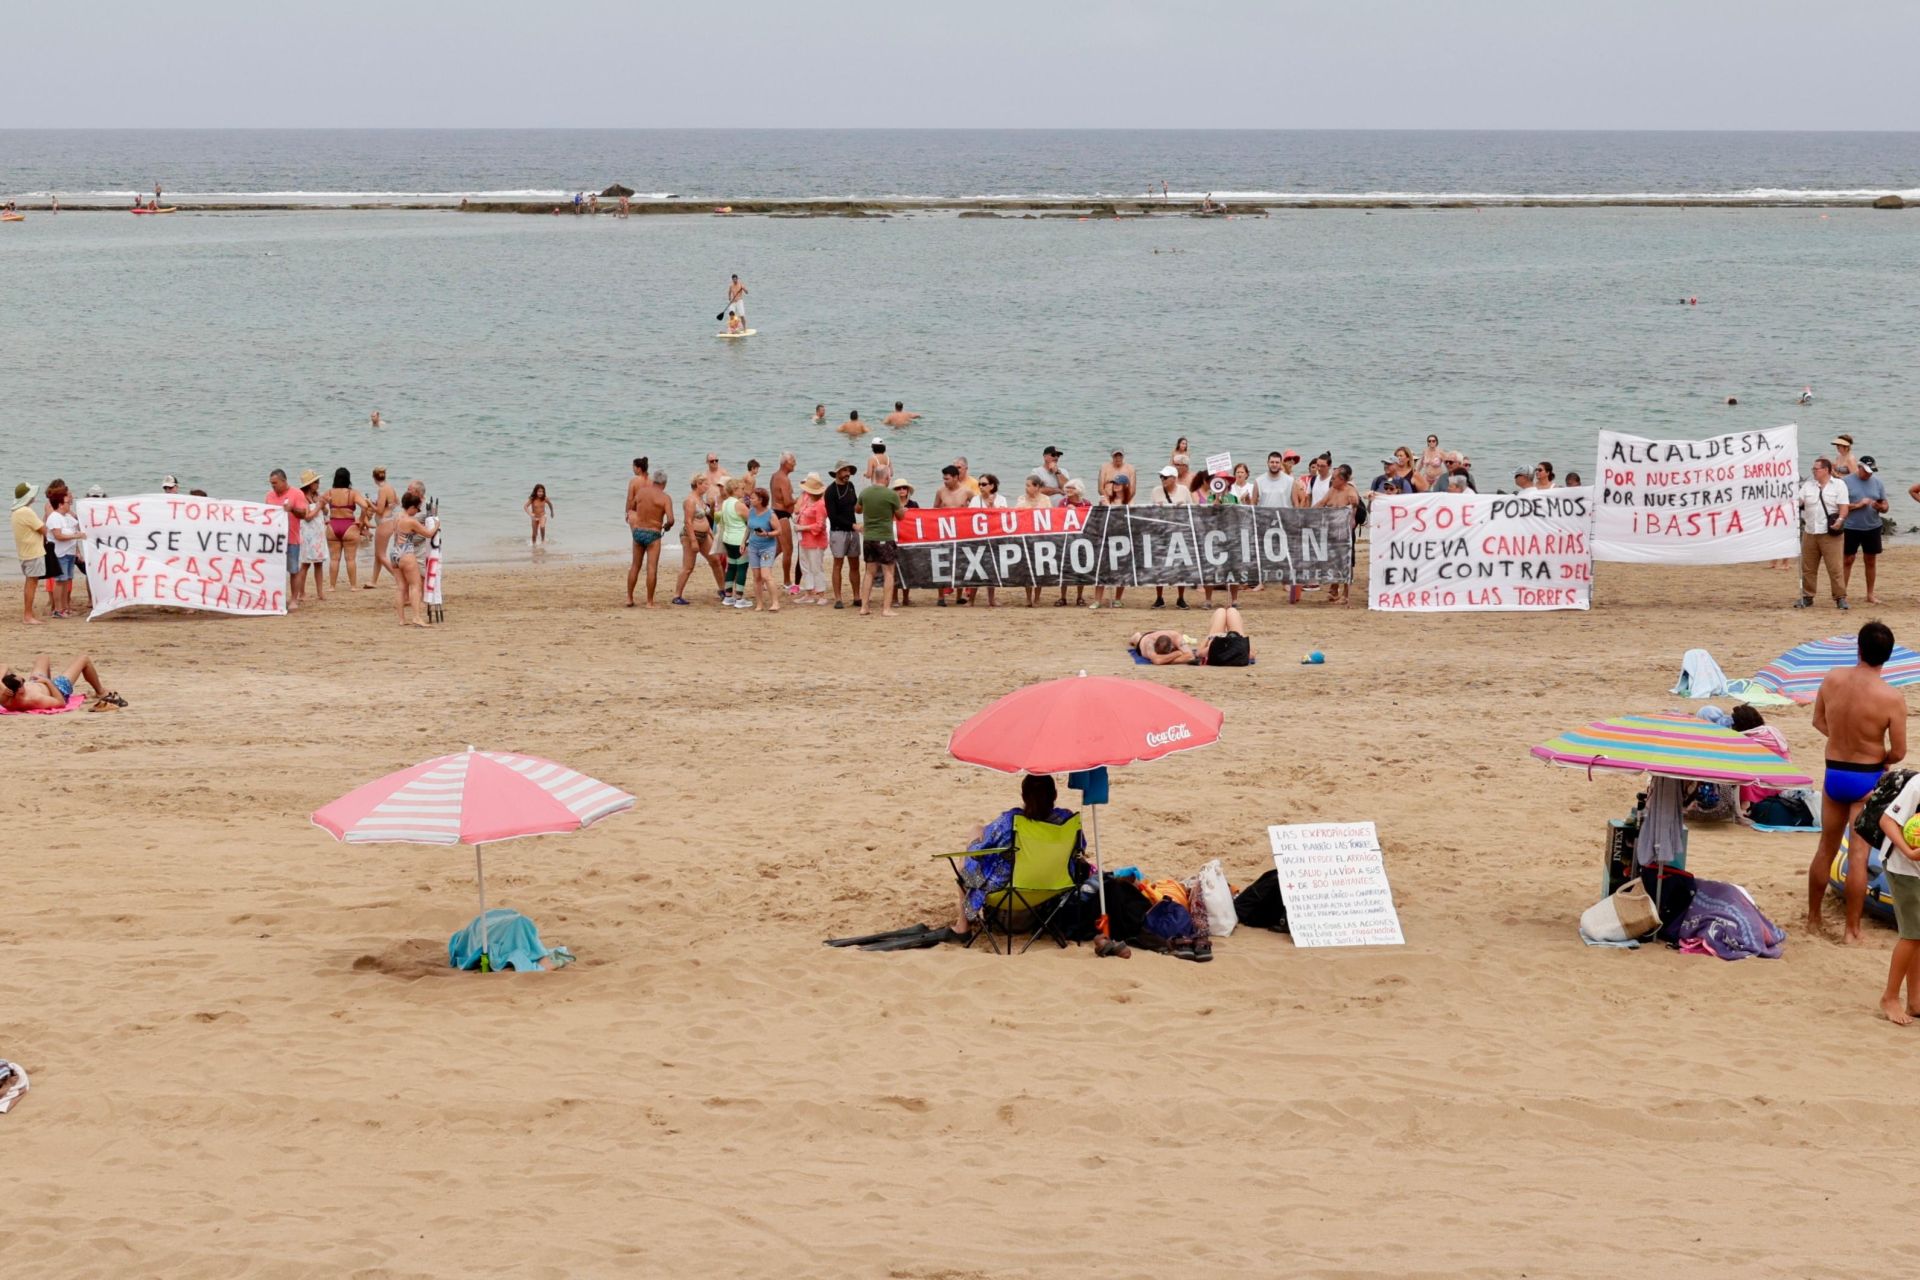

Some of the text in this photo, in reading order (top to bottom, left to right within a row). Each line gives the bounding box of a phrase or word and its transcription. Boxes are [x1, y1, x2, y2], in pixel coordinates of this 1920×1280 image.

[1605, 456, 1793, 486] POR NUESTROS BARRIOS
[1603, 480, 1794, 507] POR NUESTRAS FAMILIAS
[90, 502, 141, 527] LAS
[893, 508, 1081, 542] INGUNA
[1390, 505, 1475, 532] PSOE
[146, 531, 182, 551] SE
[197, 531, 286, 553] VENDE
[930, 520, 1329, 583] EXPROPIACIÓN
[1390, 538, 1469, 560] NUEVA
[1215, 571, 1249, 583] LAS
[1385, 561, 1590, 586] EN CONTRA DEL
[1378, 586, 1456, 608] BARRIO
[1467, 587, 1502, 605] LAS
[1276, 830, 1298, 840] LAS
[1280, 843, 1298, 852] DEL
[1334, 841, 1348, 850] LAS
[1613, 829, 1624, 861] INTEX
[1335, 854, 1346, 863] EL
[1339, 865, 1356, 876] VIDA
